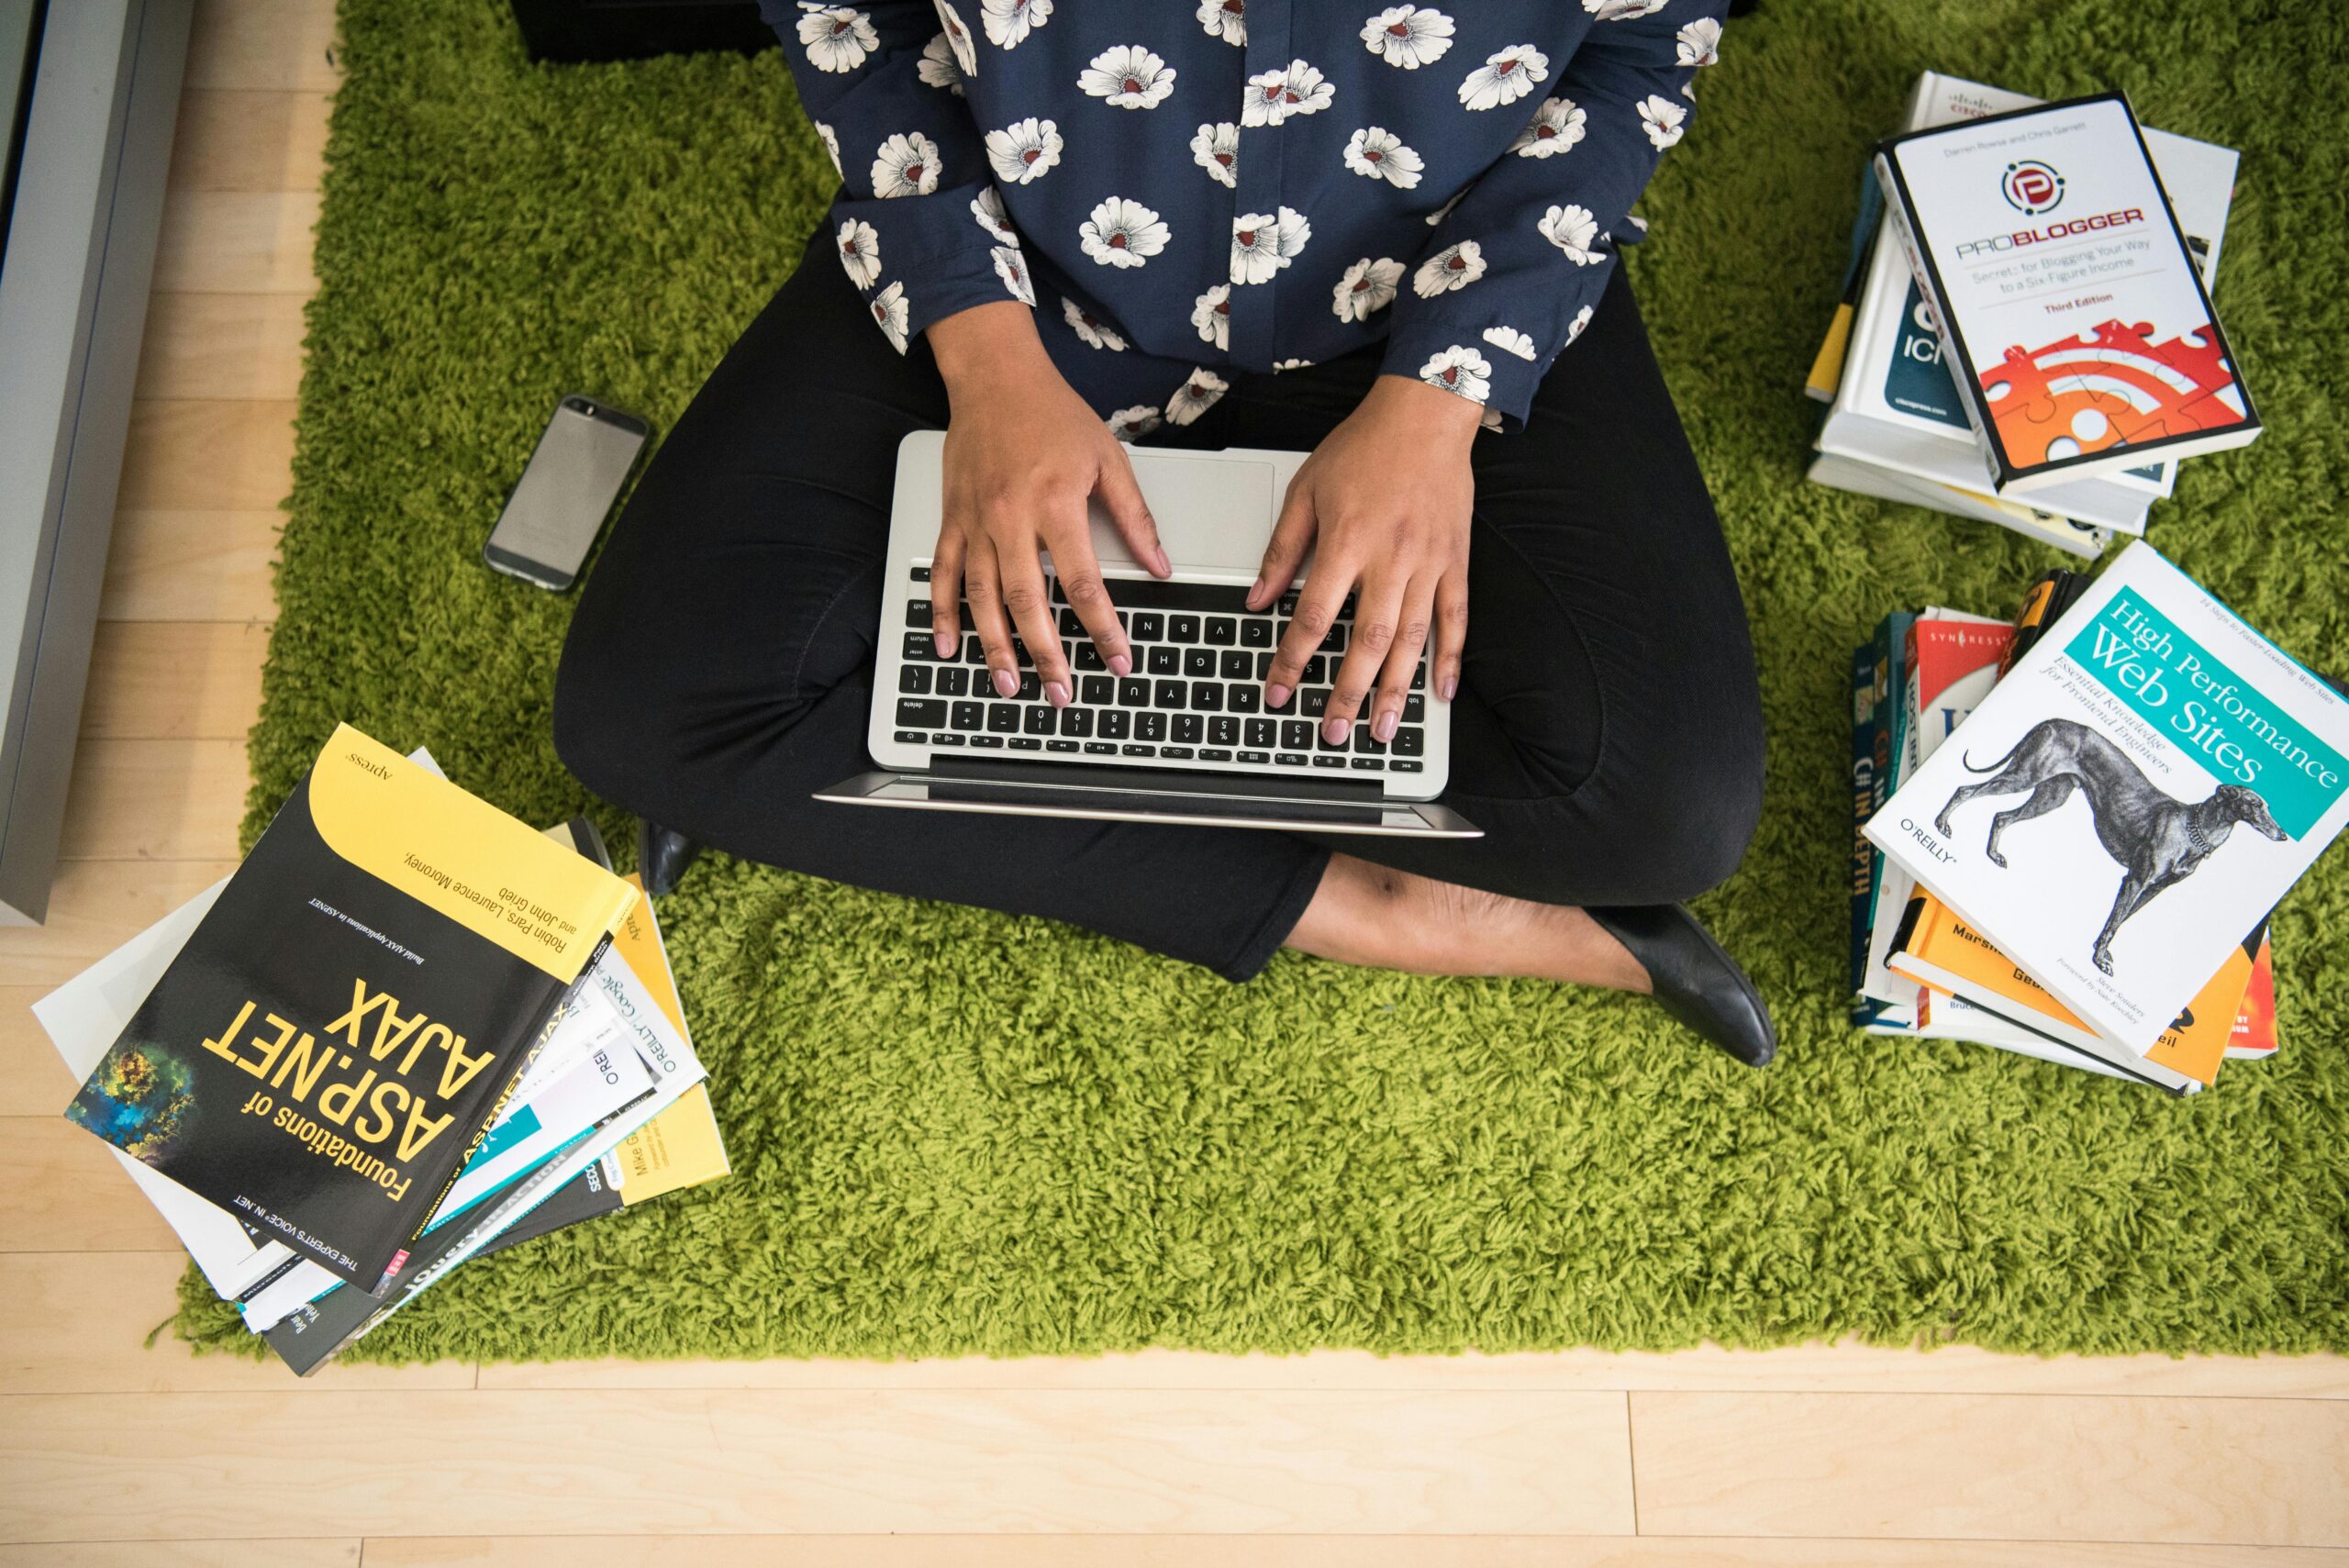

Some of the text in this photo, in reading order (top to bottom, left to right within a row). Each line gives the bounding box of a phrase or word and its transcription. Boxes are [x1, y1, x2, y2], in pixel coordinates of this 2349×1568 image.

[2009, 134, 2027, 145] and
[1955, 208, 2144, 260] PROBLOGGER
[2021, 262, 2038, 272] for
[2041, 250, 2096, 269] Blogging
[2097, 243, 2122, 257] Your
[2125, 239, 2150, 251] Way
[2000, 258, 2134, 294] to a Six-Figure Income
[2044, 293, 2114, 315] Third Edition
[1144, 622, 1152, 630] N
[1181, 624, 1187, 632] B
[1216, 626, 1224, 635] V
[1252, 628, 1261, 637] C
[909, 635, 930, 643] return
[1088, 651, 1096, 660] K
[1160, 656, 1168, 665] H
[1197, 658, 1205, 667] G
[1233, 660, 1240, 669] F
[1306, 663, 1313, 673] S
[1021, 681, 1029, 690] P
[1130, 687, 1138, 696] U
[1167, 690, 1174, 698] Y
[1205, 692, 1210, 701] T
[1241, 694, 1248, 703] R
[1312, 697, 1322, 706] W
[2110, 599, 2174, 662] High
[2175, 652, 2339, 789] Performance
[903, 700, 924, 708] delete
[2053, 655, 2106, 702] Essential
[2103, 698, 2167, 751] Knowledge
[2091, 622, 2169, 707] Web
[2171, 701, 2263, 784] Sites
[1038, 710, 1044, 718] 0
[1074, 712, 1081, 721] 9
[1111, 714, 1118, 723] 8
[1148, 717, 1153, 725] 7
[2039, 666, 2174, 774] for Frontend Engineers
[1184, 717, 1191, 727] 6
[1221, 720, 1228, 729] 5
[1257, 722, 1264, 731] 4
[1295, 725, 1301, 733] 3
[344, 751, 394, 781] Apress
[1853, 756, 1874, 788] C#
[1854, 791, 1872, 818] IN
[404, 852, 568, 954] Robin Pars, Laurence Moroney,
[499, 886, 577, 935] and John Grieb
[308, 896, 425, 965] Build AJAX Applications in ASP.NET
[1952, 923, 2004, 956] Mars
[602, 975, 636, 1018] Google
[2096, 975, 2146, 1018] Steve Souders
[323, 977, 496, 1100] AJAX
[638, 1025, 676, 1073] O'REILLY
[201, 1000, 456, 1163] ASP.NET
[412, 1179, 454, 1241] Foundations
[452, 1166, 462, 1180] of
[463, 1066, 525, 1164] ASP.NET
[528, 1001, 568, 1065] AJAX
[240, 1091, 413, 1202] Foundations of
[632, 1147, 649, 1176] Mike
[233, 1194, 255, 1209] .NET
[254, 1206, 266, 1218] IN
[405, 1228, 480, 1291] jQuery
[502, 1154, 567, 1209] ACTION
[296, 1229, 340, 1261] EXPERT'S
[338, 1254, 359, 1272] THE
[290, 1314, 307, 1334] Bear
